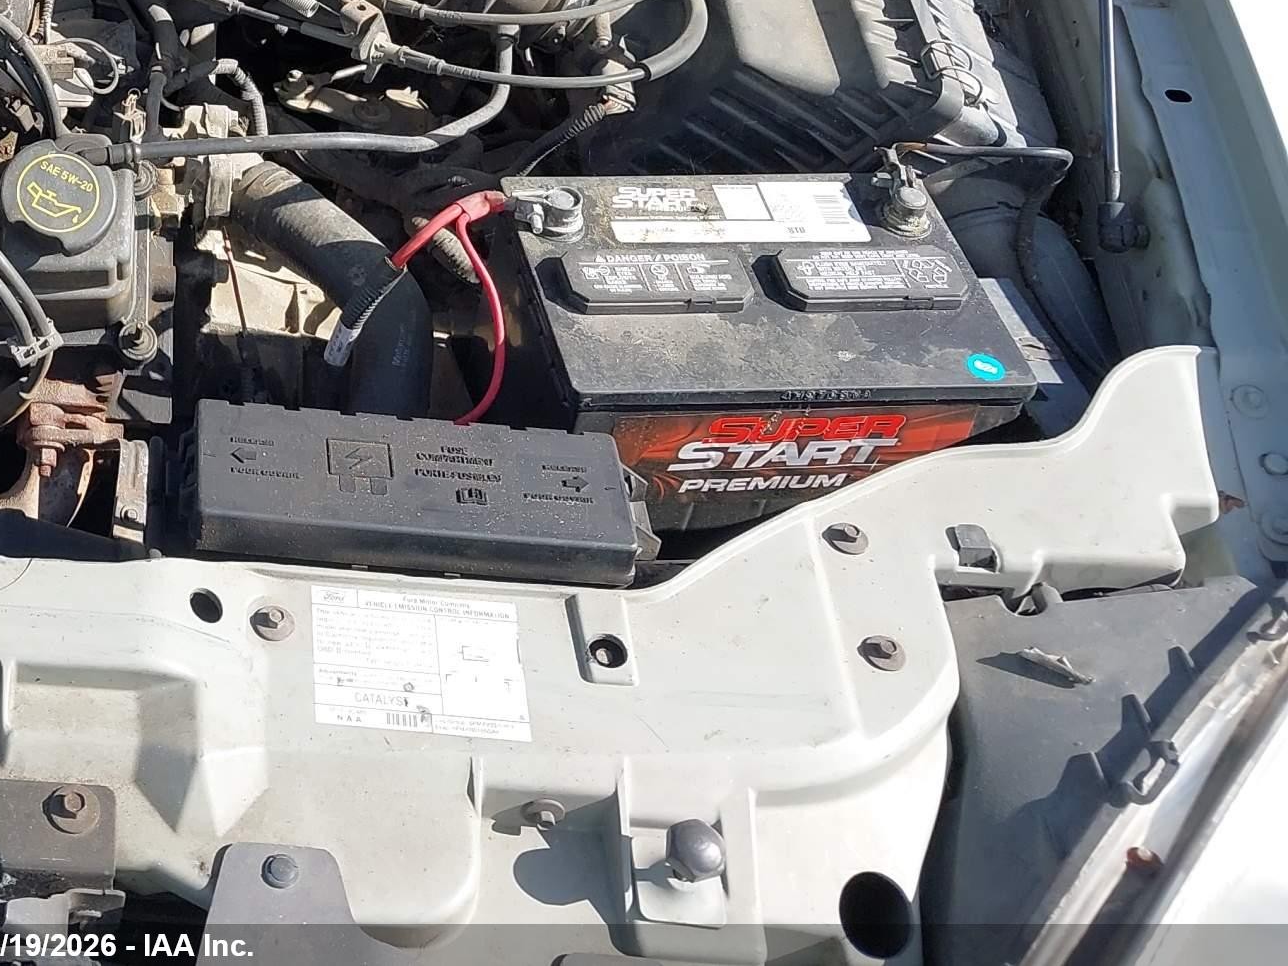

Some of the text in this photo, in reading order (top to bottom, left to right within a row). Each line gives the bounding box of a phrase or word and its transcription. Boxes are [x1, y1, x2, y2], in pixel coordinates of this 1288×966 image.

[40, 160, 94, 193] SAE 5W-20
[617, 186, 696, 198] SUPER
[611, 195, 699, 209] START
[606, 254, 653, 263] DANGER
[663, 254, 706, 262] POISON
[704, 415, 907, 444] SUPER
[440, 446, 468, 456] FUSE
[667, 438, 899, 471] START
[678, 473, 848, 494] PREMIUM
[365, 601, 392, 609] VEHICLE
[393, 603, 428, 611] EMISSION
[429, 606, 461, 615] CONTROL
[462, 610, 510, 620] INFORMATION
[355, 691, 410, 707] CATALYST
